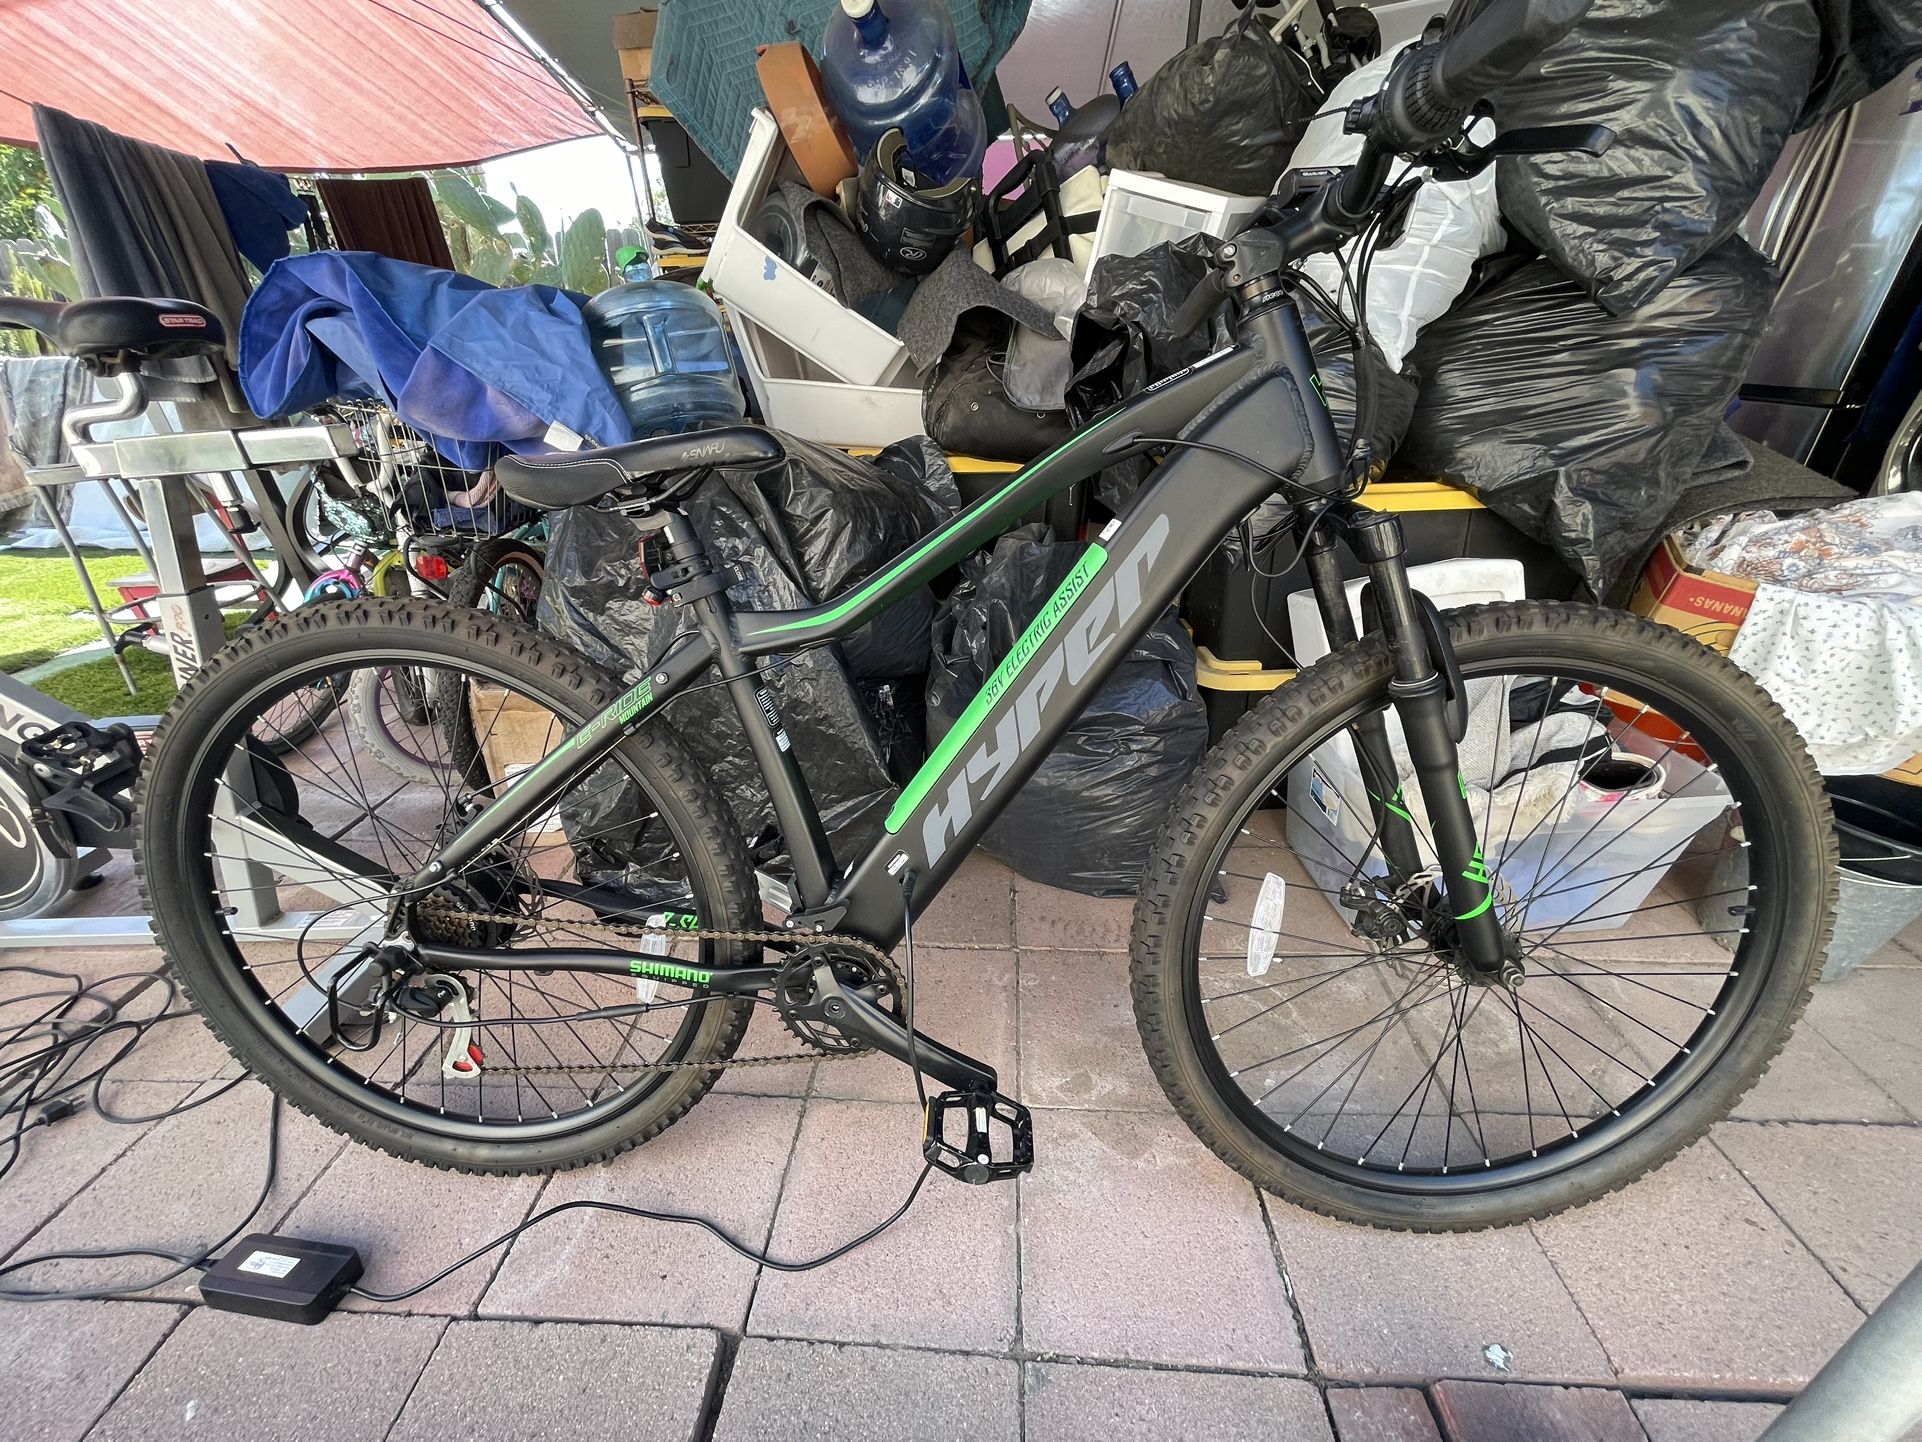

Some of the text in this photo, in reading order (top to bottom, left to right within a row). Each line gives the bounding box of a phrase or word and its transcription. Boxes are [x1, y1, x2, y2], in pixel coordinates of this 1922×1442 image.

[985, 561, 1090, 706] 36V ELECTRIC ASSIST
[576, 675, 652, 750] E-RIDE
[619, 692, 654, 726] MOUNTAIN
[630, 960, 710, 983] SHIMANO
